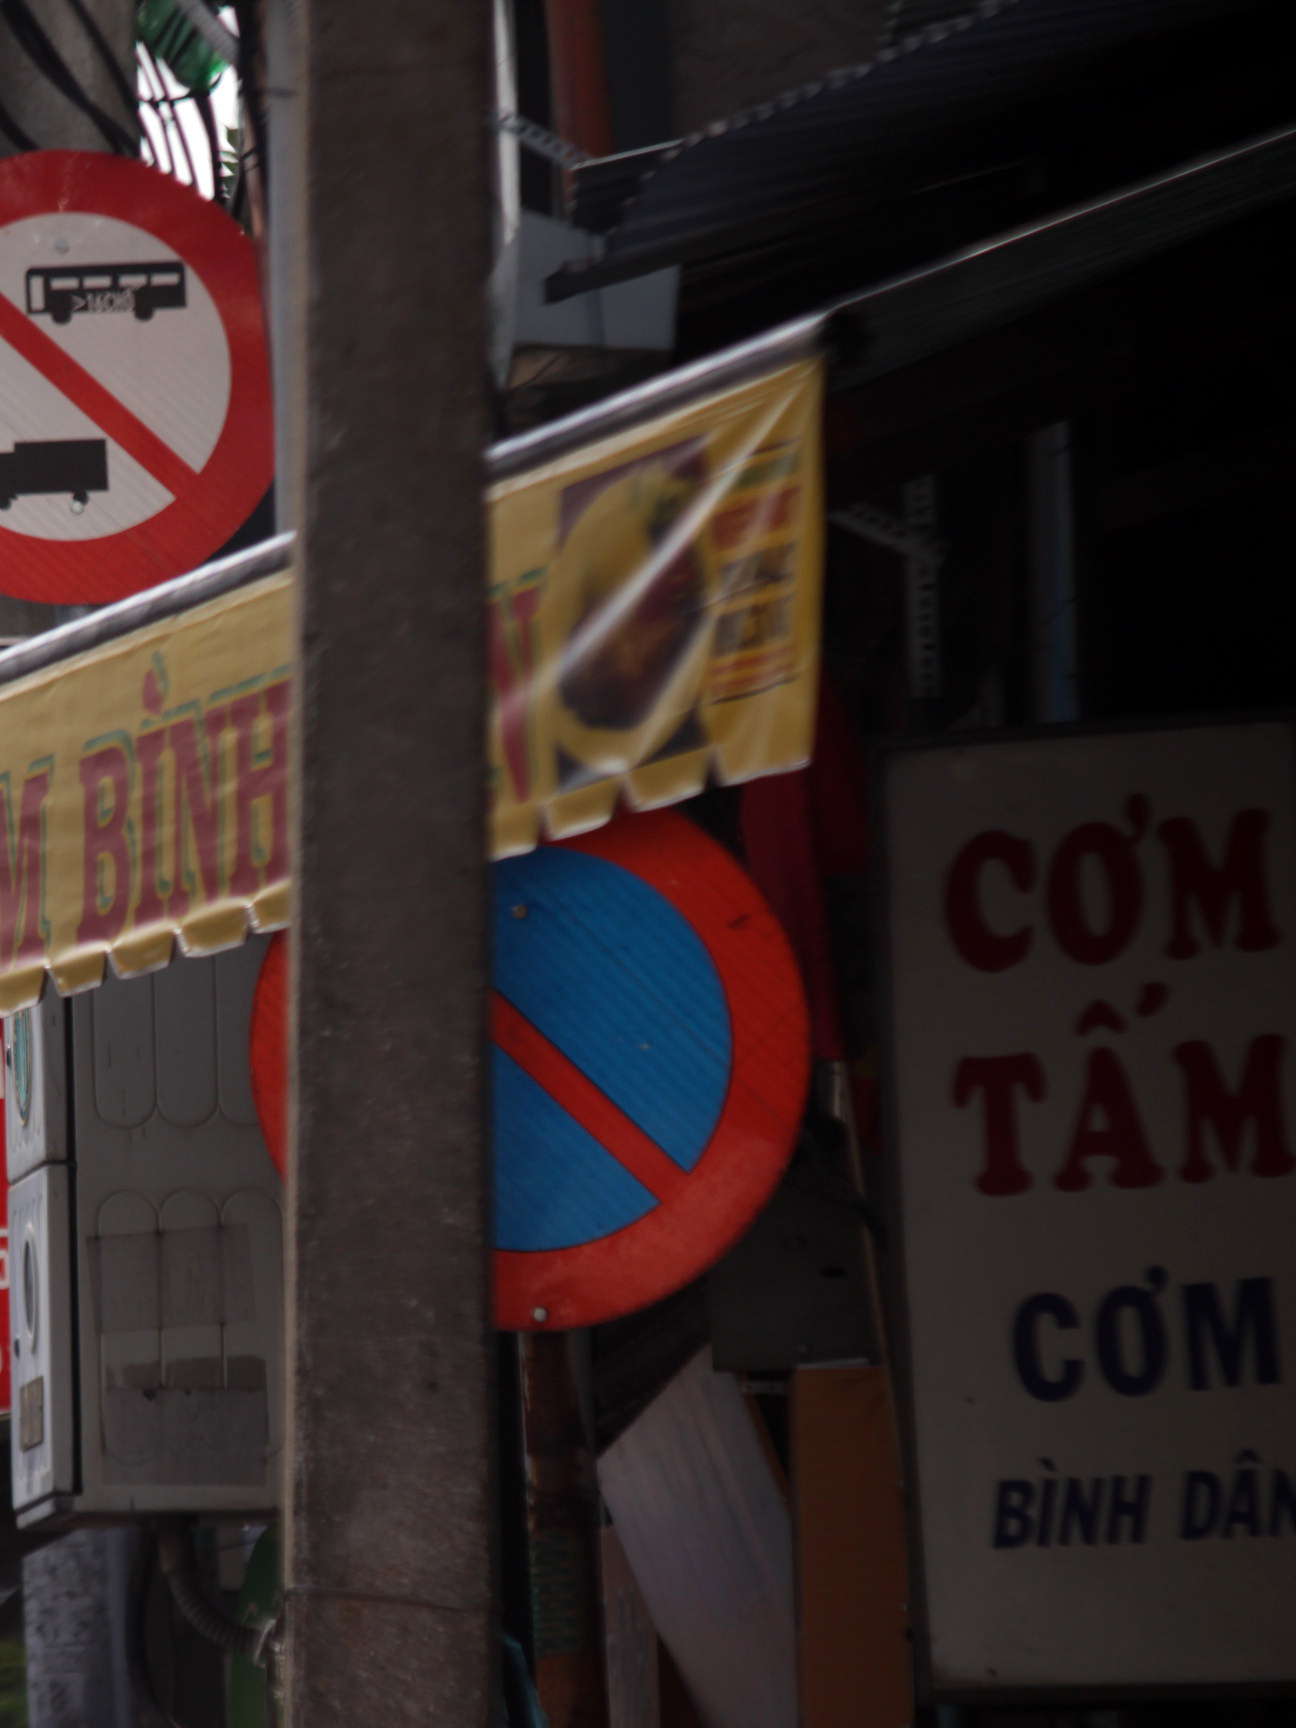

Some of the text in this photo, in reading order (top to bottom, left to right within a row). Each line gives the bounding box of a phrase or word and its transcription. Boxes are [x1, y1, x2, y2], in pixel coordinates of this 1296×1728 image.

[945, 793, 1282, 973] CƠM
[953, 982, 1296, 1195] TẤM
[1014, 1265, 1281, 1401] CƠM
[992, 1457, 1153, 1549] BÌNH
